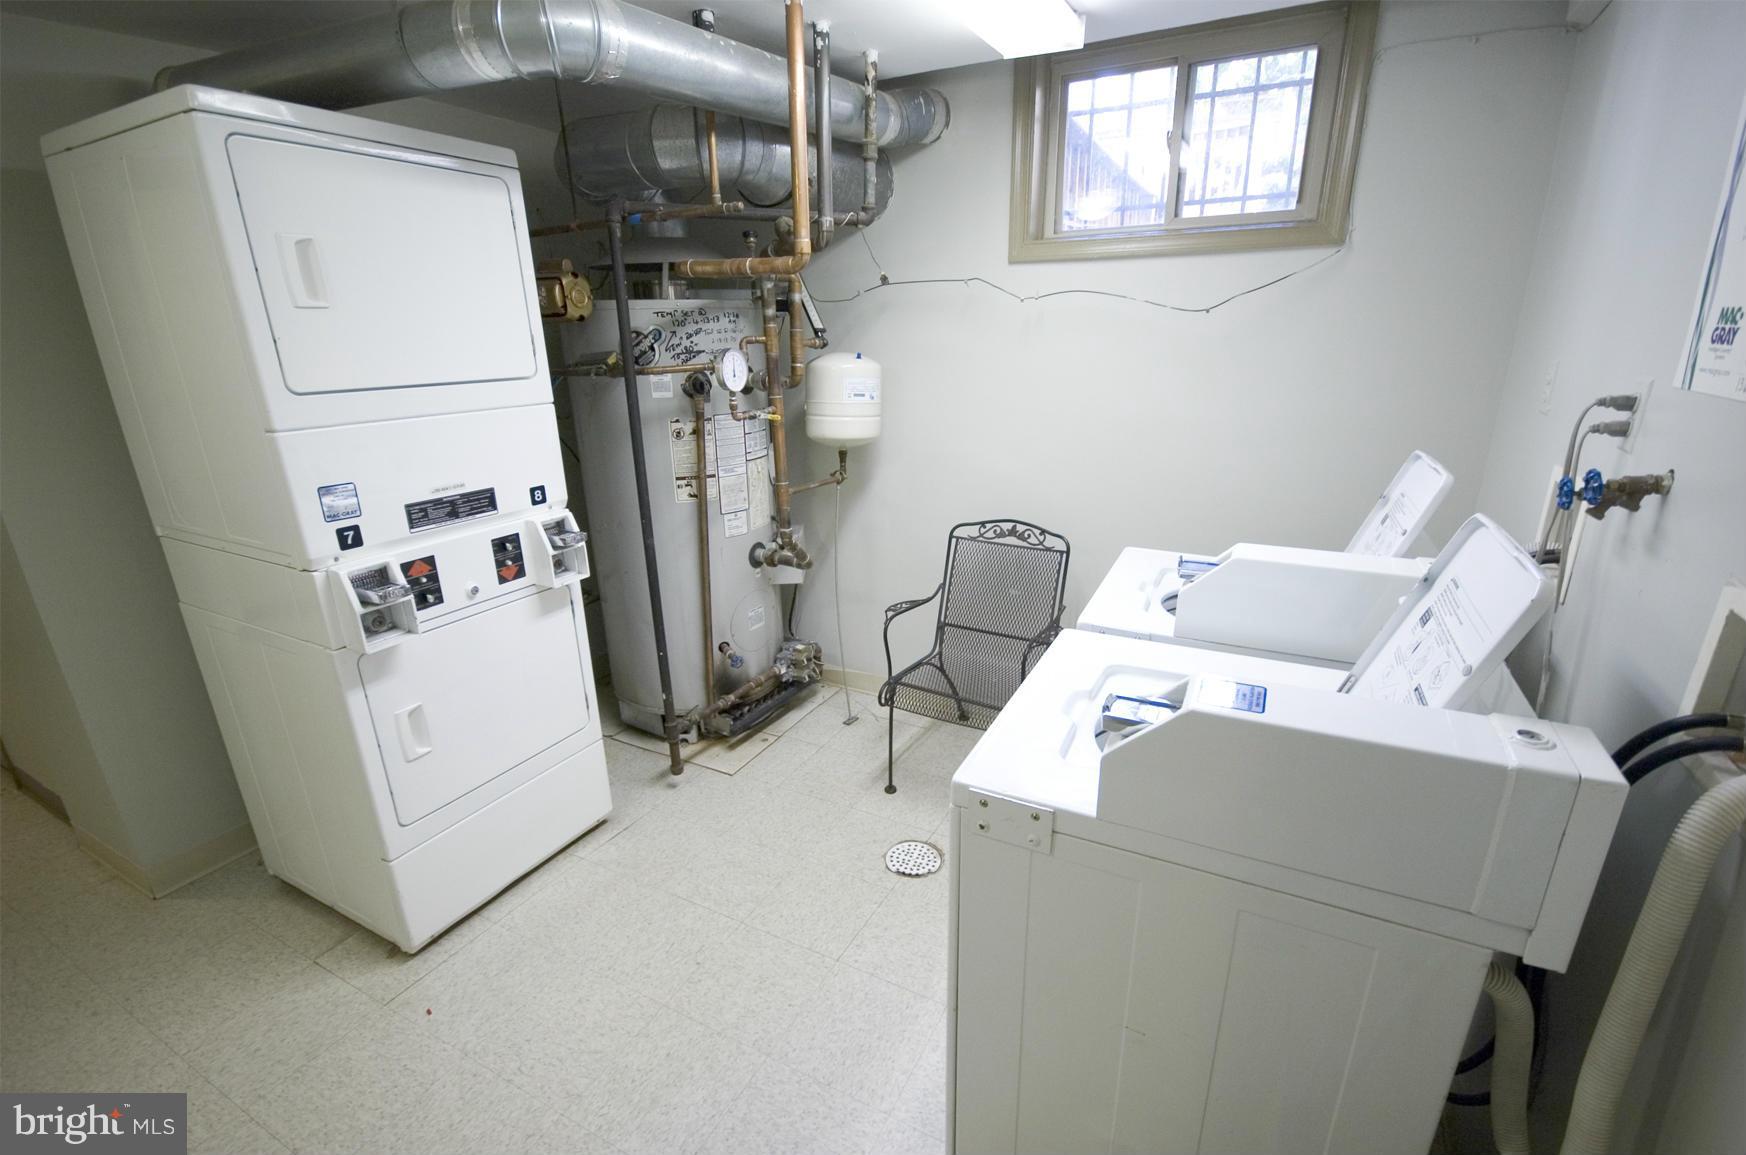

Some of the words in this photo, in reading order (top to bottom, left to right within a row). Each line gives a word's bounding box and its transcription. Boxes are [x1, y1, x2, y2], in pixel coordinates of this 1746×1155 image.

[1711, 326, 1740, 345] GRAY
[534, 489, 543, 502] 8
[343, 530, 354, 545] 7
